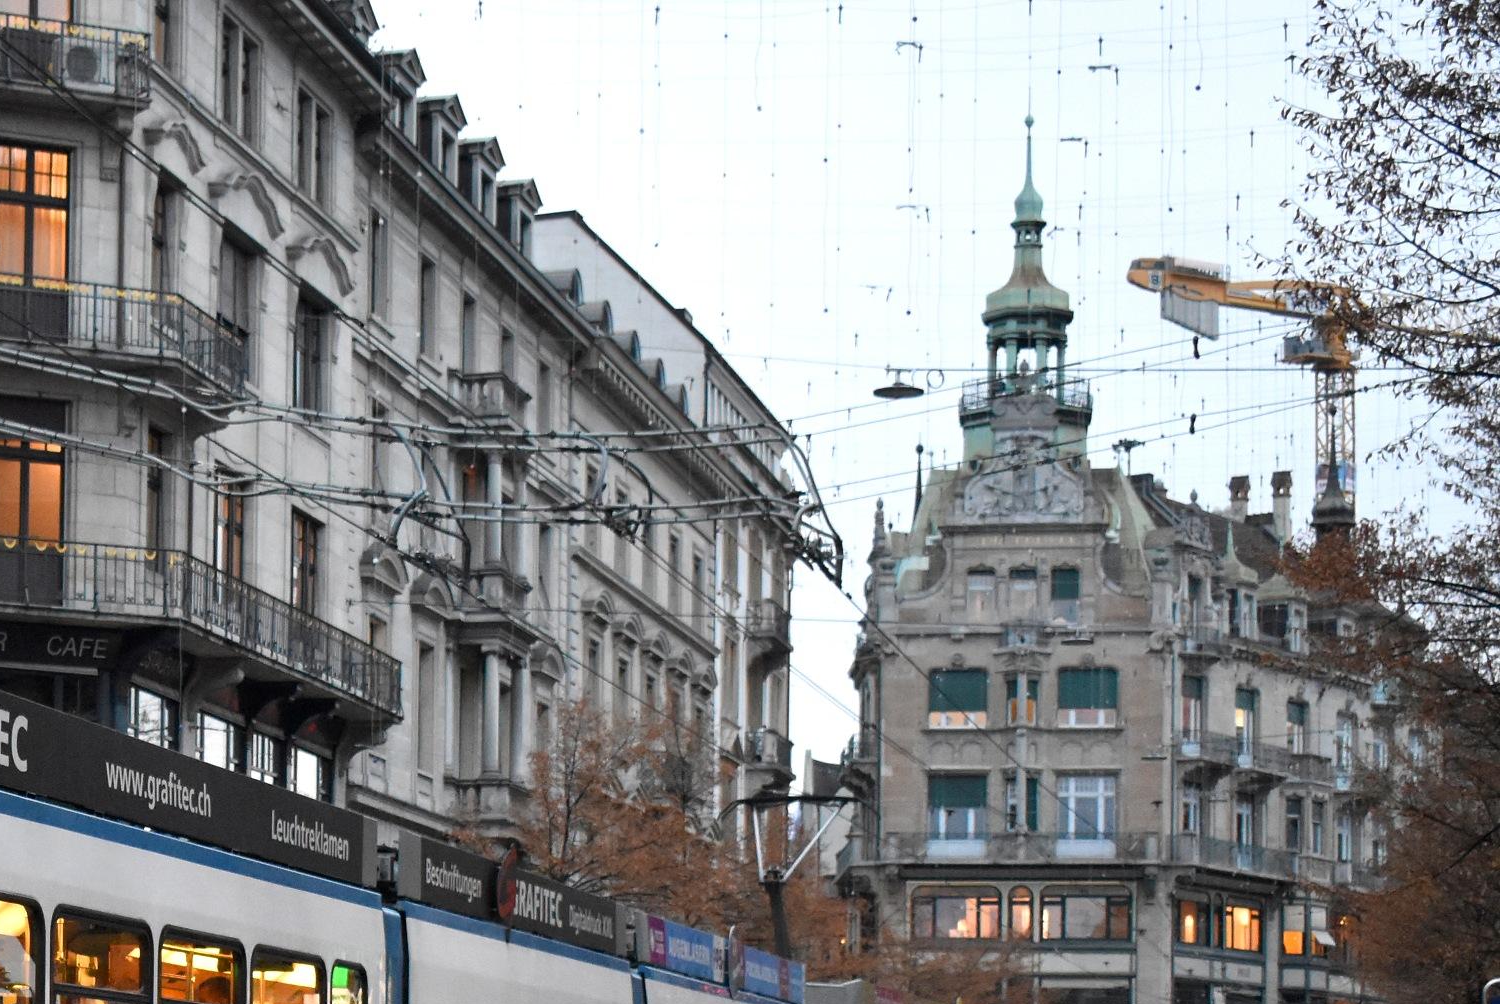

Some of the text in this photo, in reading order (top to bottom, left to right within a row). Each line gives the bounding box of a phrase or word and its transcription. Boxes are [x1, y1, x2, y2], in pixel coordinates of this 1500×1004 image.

[46, 636, 109, 659] CAFE
[105, 761, 212, 818] www.grafitec.ch
[271, 810, 349, 862] Leuchtreklamen
[425, 857, 482, 904] Beschriftungen
